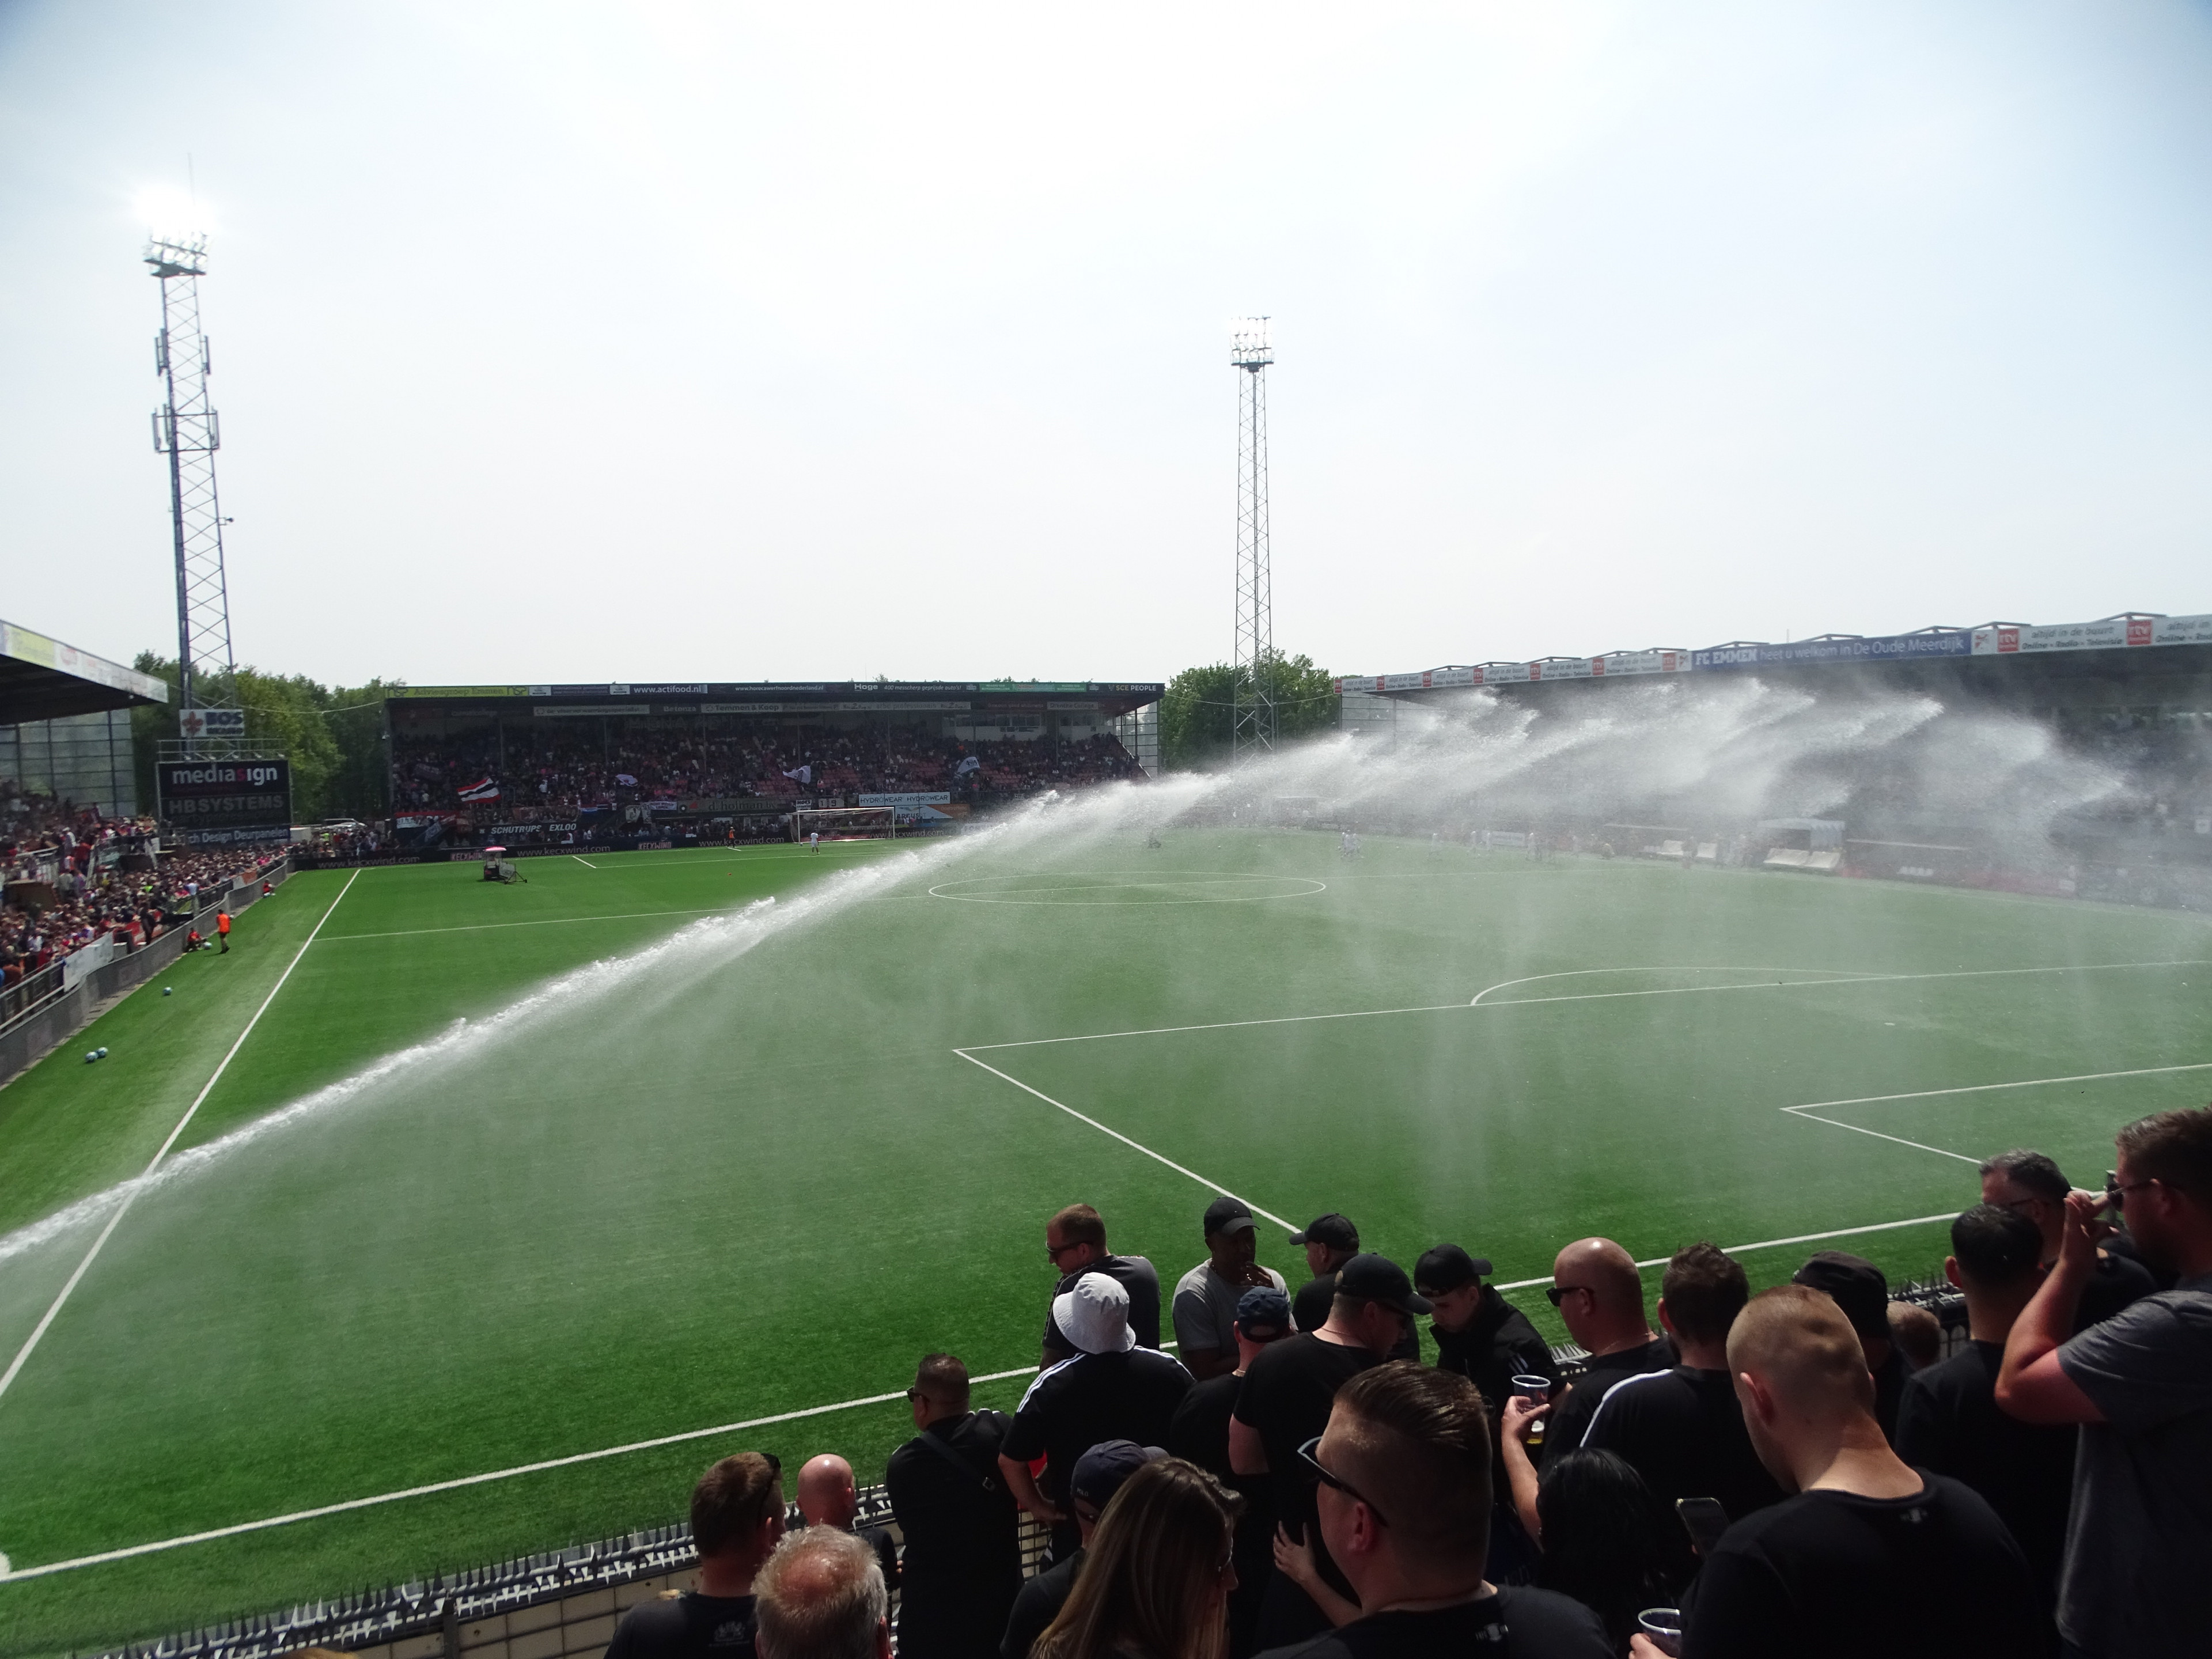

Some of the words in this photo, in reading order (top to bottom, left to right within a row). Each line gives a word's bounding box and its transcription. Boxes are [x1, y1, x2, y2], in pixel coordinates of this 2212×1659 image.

[1695, 653, 1710, 665] FC
[1713, 649, 1757, 664] EMMEN
[1760, 650, 1782, 661] heet
[1785, 650, 1792, 658] u
[1795, 647, 1838, 658] welkom
[1854, 643, 1869, 655] De
[1872, 641, 1904, 654] Oude
[1908, 635, 1964, 653] Meerdijk
[634, 684, 702, 694] www.actifood.nl
[759, 704, 779, 712] Koop
[172, 764, 278, 786] mediasign
[907, 794, 949, 802] HYDROWEAR
[721, 801, 763, 810] holman
[491, 825, 542, 835] SCHUTRUPS
[549, 823, 577, 831] EXLOO
[870, 829, 944, 839] www.kecxwind.com
[517, 844, 611, 857] www.kecxwind.com
[638, 842, 672, 850] KECXWIND
[317, 855, 420, 869] www.kecxwind.com
